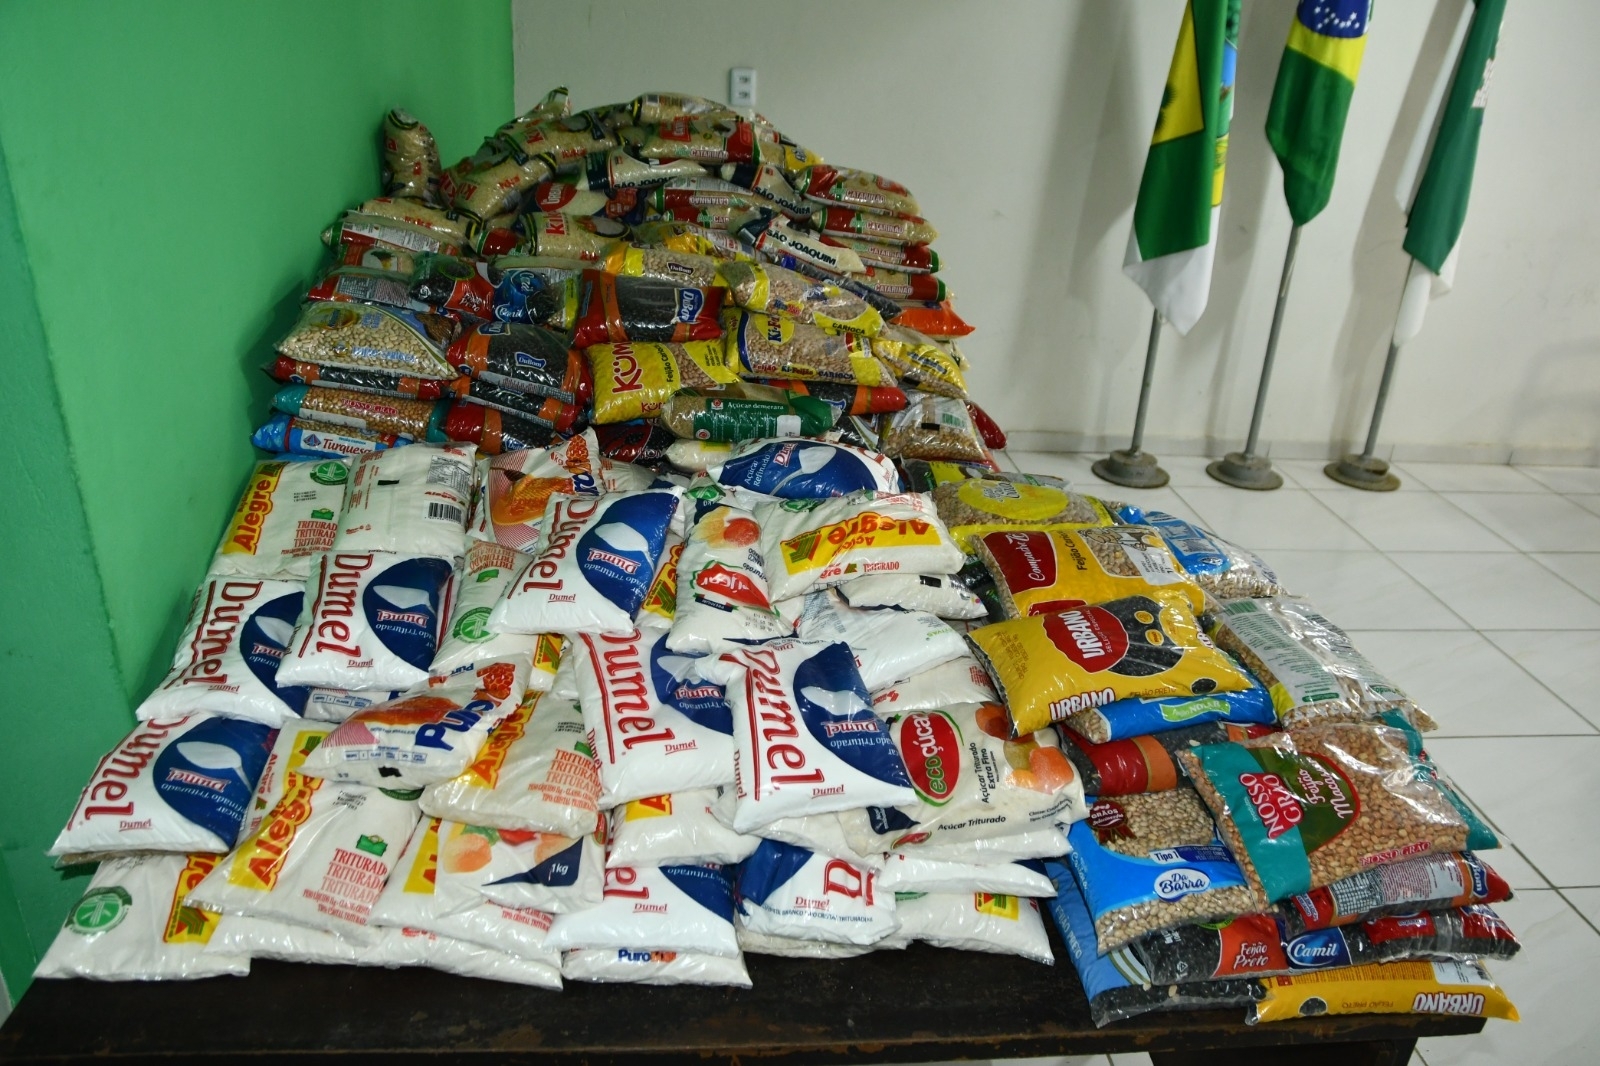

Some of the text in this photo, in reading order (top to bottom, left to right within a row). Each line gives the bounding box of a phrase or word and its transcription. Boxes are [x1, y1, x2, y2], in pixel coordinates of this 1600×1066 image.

[754, 186, 775, 202] SÃO
[766, 228, 837, 266] SÃO JOAQUIM
[832, 322, 866, 335] CARIOCA
[664, 361, 674, 384] Feijão
[727, 401, 785, 411] Açúcar demerara
[743, 458, 760, 486] Açúcar
[752, 454, 772, 487] Refinado
[232, 477, 274, 554] Alegre
[827, 513, 931, 546] Alegre
[587, 548, 641, 575] Dumel
[1018, 541, 1046, 582] Compadre
[1068, 548, 1088, 571] Feijão
[584, 563, 624, 581] Triturado
[316, 553, 375, 658] Dumel
[548, 593, 577, 603] Dumel
[376, 609, 429, 628] Dumel
[182, 581, 264, 686] Dumel
[375, 623, 418, 636] Triturado
[1058, 609, 1106, 660] URBANO
[347, 658, 374, 669] Dumel
[674, 685, 724, 700] Dumel
[1049, 687, 1116, 721] URBANO
[821, 718, 880, 738] Dumel
[586, 728, 604, 770] Dumel
[664, 740, 697, 753] Dumel
[830, 738, 876, 749] Triturado
[258, 753, 278, 795] Alegre
[733, 749, 748, 799] Dumel
[968, 742, 990, 804] Açúcar Triturado
[980, 748, 997, 790] Extra Fino
[168, 768, 230, 794] Dumel
[1297, 768, 1326, 804] Feijão
[161, 782, 210, 801] Triturado
[812, 785, 845, 797] Dumel
[1262, 774, 1302, 823] GRÃO
[1090, 808, 1119, 820] GRÃOS
[1239, 772, 1285, 839] NOSSO
[119, 820, 152, 832] Dumel
[938, 813, 1007, 832] Açúcar Triturado
[1154, 853, 1174, 862] Tipo
[1359, 841, 1431, 866] NOSSO GRÃO
[551, 862, 569, 876] 1kg
[1171, 872, 1189, 883] Da
[1159, 878, 1206, 894] Barra
[633, 902, 668, 913] Dumel
[795, 896, 831, 908] Dumel
[618, 948, 651, 962] Puro
[1065, 933, 1083, 960] PRETO
[1240, 942, 1268, 956] Feijão
[1293, 941, 1338, 957] Camil
[1234, 954, 1269, 970] Preto
[1341, 1001, 1368, 1010] PRETO
[1411, 992, 1486, 1015] URBANO
